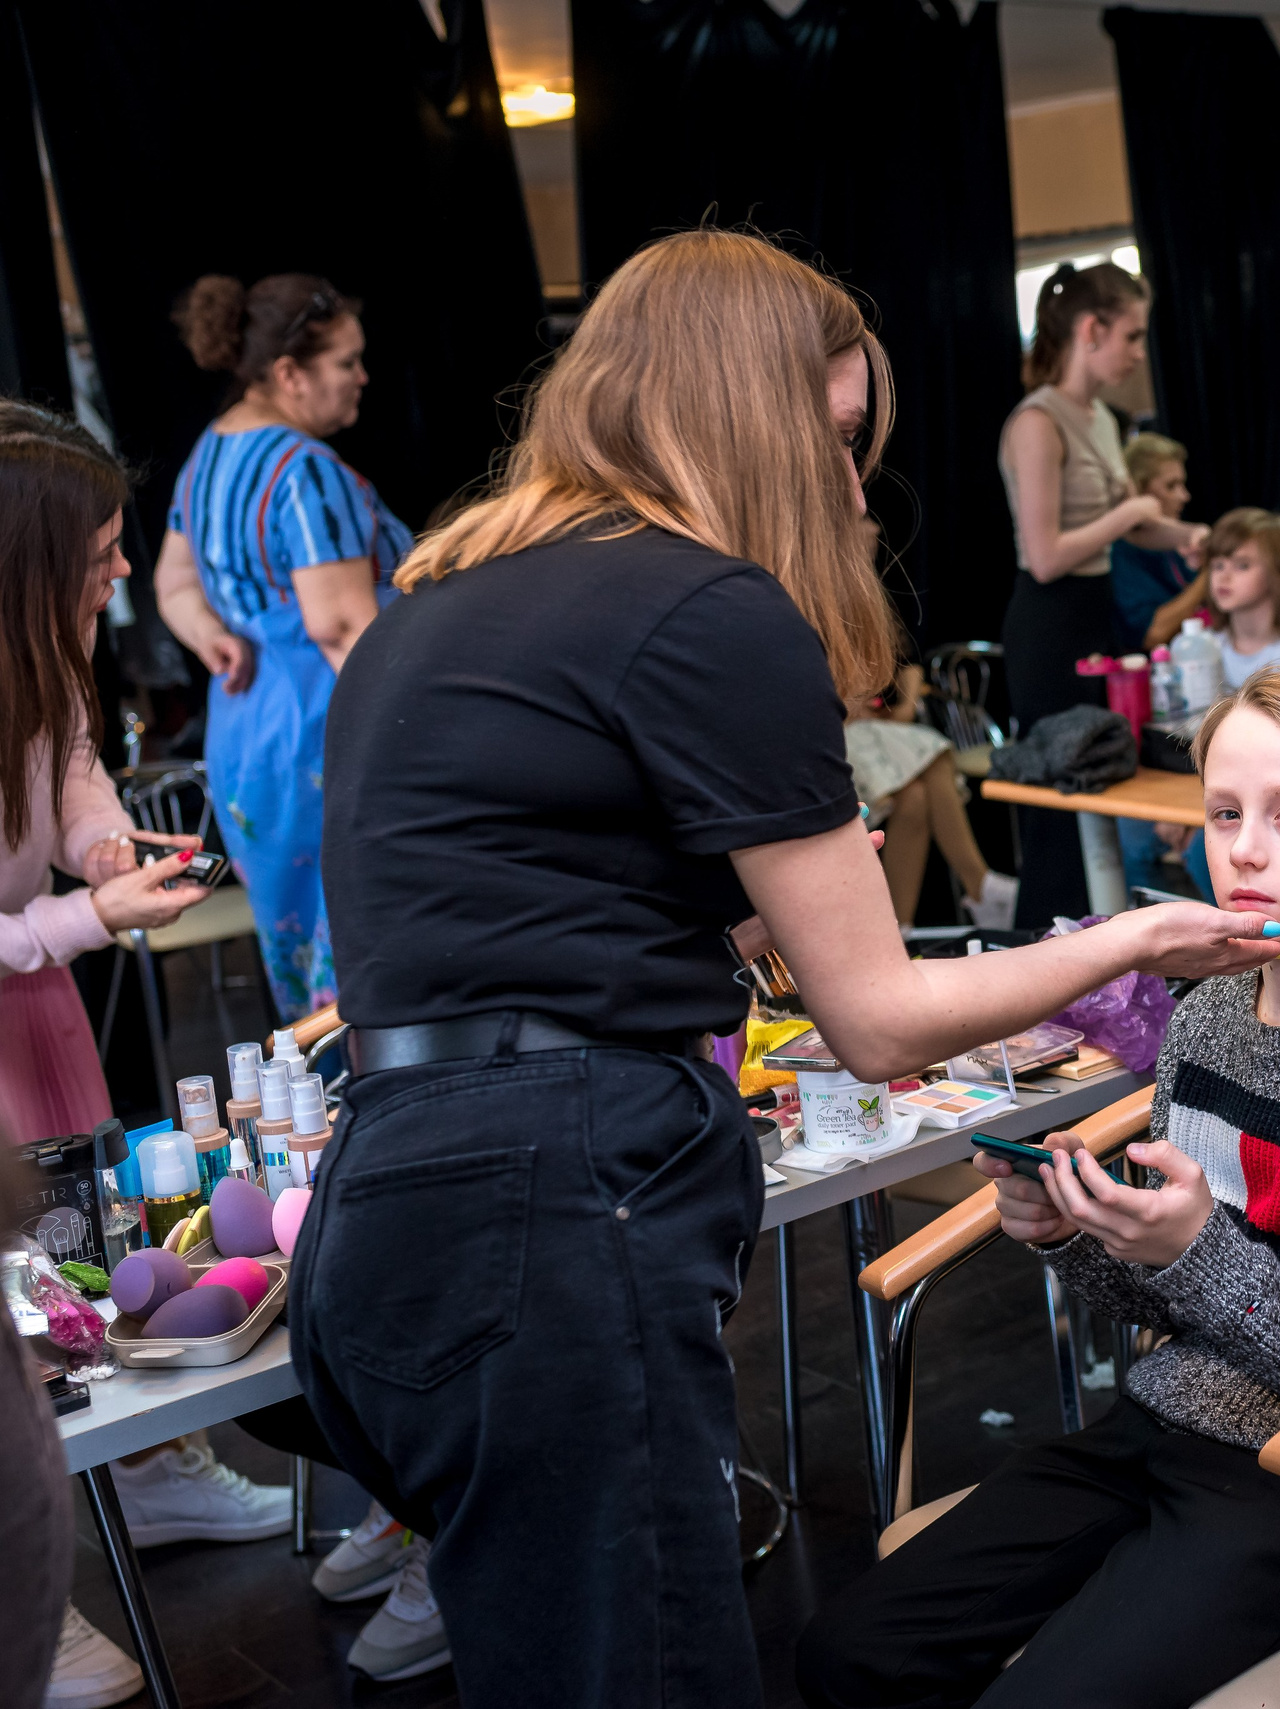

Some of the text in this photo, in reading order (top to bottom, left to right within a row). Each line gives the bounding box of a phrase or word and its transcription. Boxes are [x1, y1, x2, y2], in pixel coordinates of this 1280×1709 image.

[816, 1113, 857, 1122] Green Tea
[845, 1121, 857, 1129] pad
